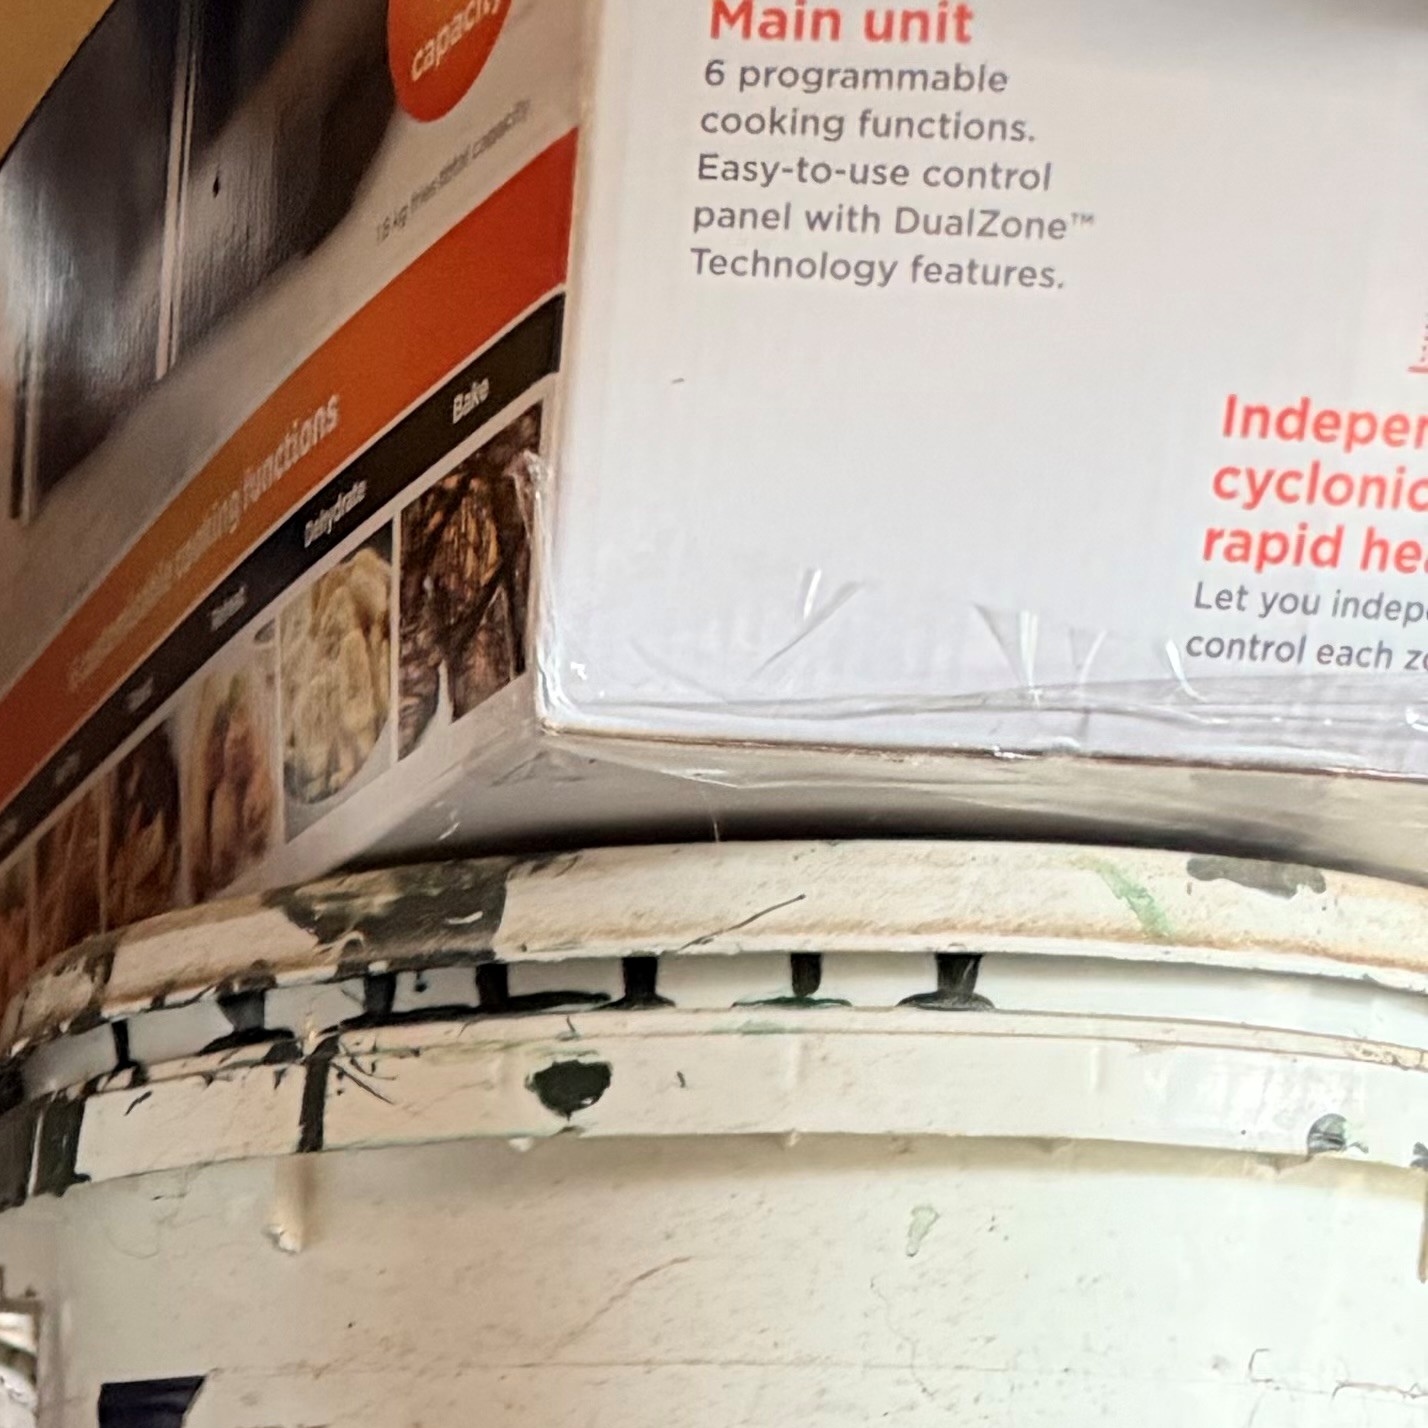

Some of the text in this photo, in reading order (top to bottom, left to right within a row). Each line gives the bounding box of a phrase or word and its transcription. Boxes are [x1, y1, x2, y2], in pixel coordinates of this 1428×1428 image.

[710, 0, 974, 45] Main unit
[704, 58, 1011, 95] 6 programmable
[699, 107, 1036, 144] cooking functions.
[697, 152, 1053, 192] Easy-to-use control
[692, 203, 792, 237] panel
[803, 207, 882, 236] with
[690, 246, 1066, 291] Technology features.
[451, 375, 491, 425] Bake
[1202, 522, 1345, 574] rapid
[1193, 580, 1428, 629] Let you indep
[1185, 633, 1393, 670] control each
